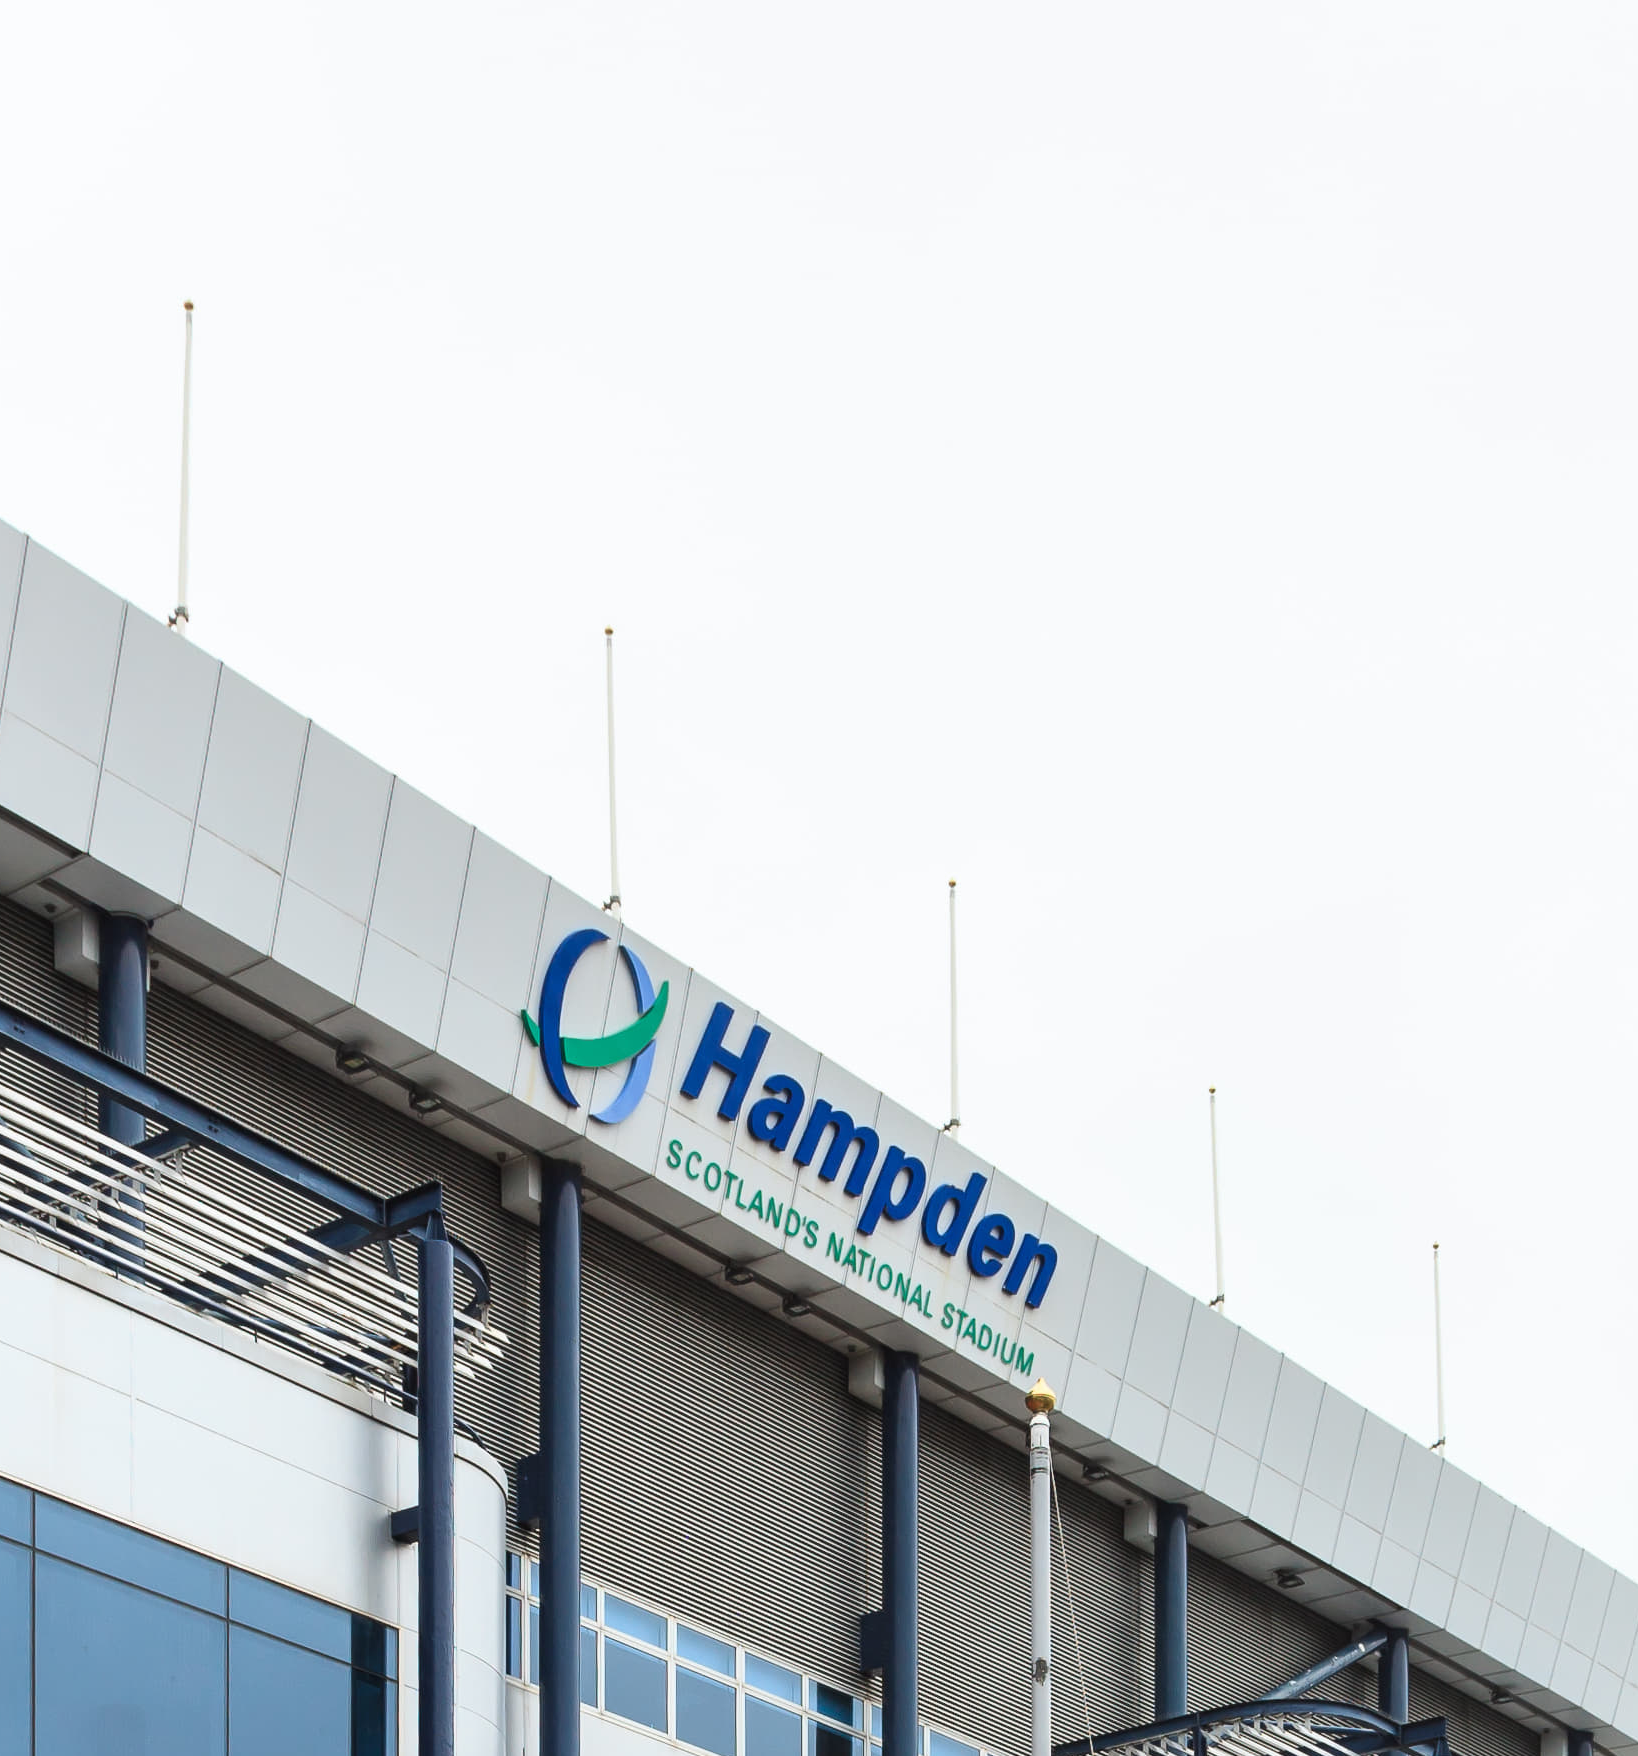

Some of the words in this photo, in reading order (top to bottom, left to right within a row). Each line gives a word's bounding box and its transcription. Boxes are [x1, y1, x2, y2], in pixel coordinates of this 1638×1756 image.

[666, 1139, 819, 1250] SCOTLAND'S
[826, 1231, 933, 1318] NATIONAL
[940, 1302, 1036, 1377] STADIUM
[679, 1001, 1058, 1309] Hampden
